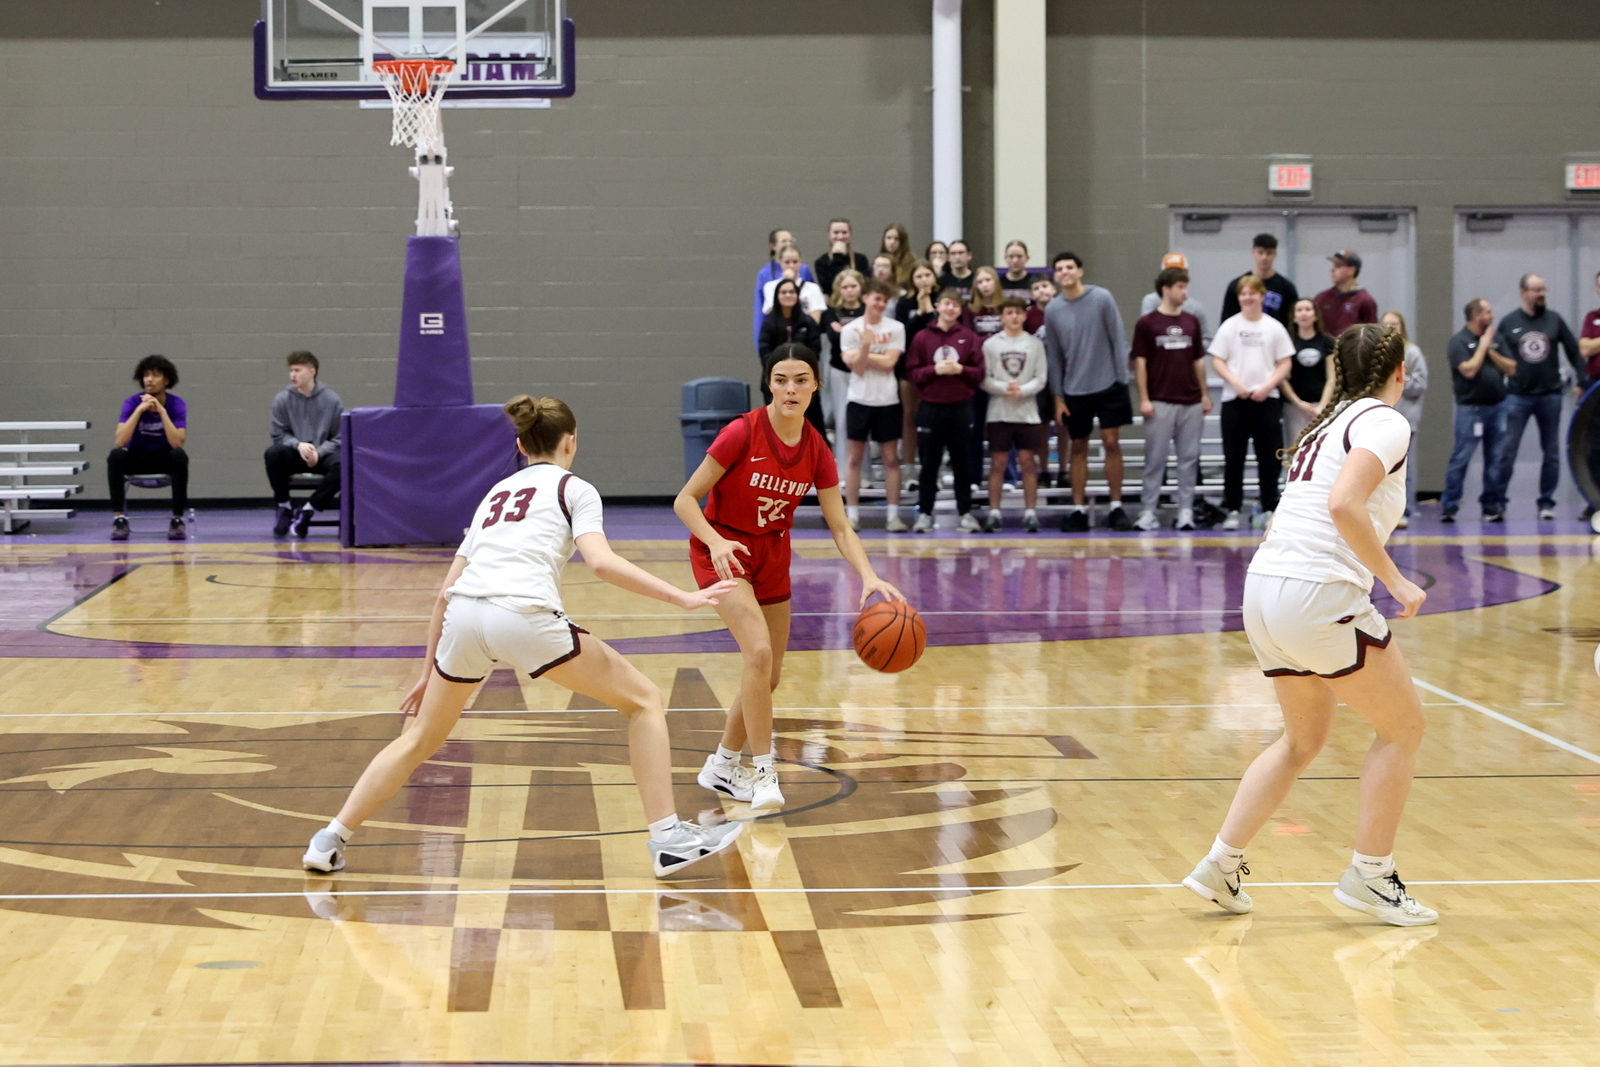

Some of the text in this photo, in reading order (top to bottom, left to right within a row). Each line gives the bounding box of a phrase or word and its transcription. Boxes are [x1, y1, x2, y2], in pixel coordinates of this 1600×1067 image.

[1277, 165, 1305, 188] EXIT
[1288, 432, 1329, 482] 31
[481, 487, 537, 530] 33
